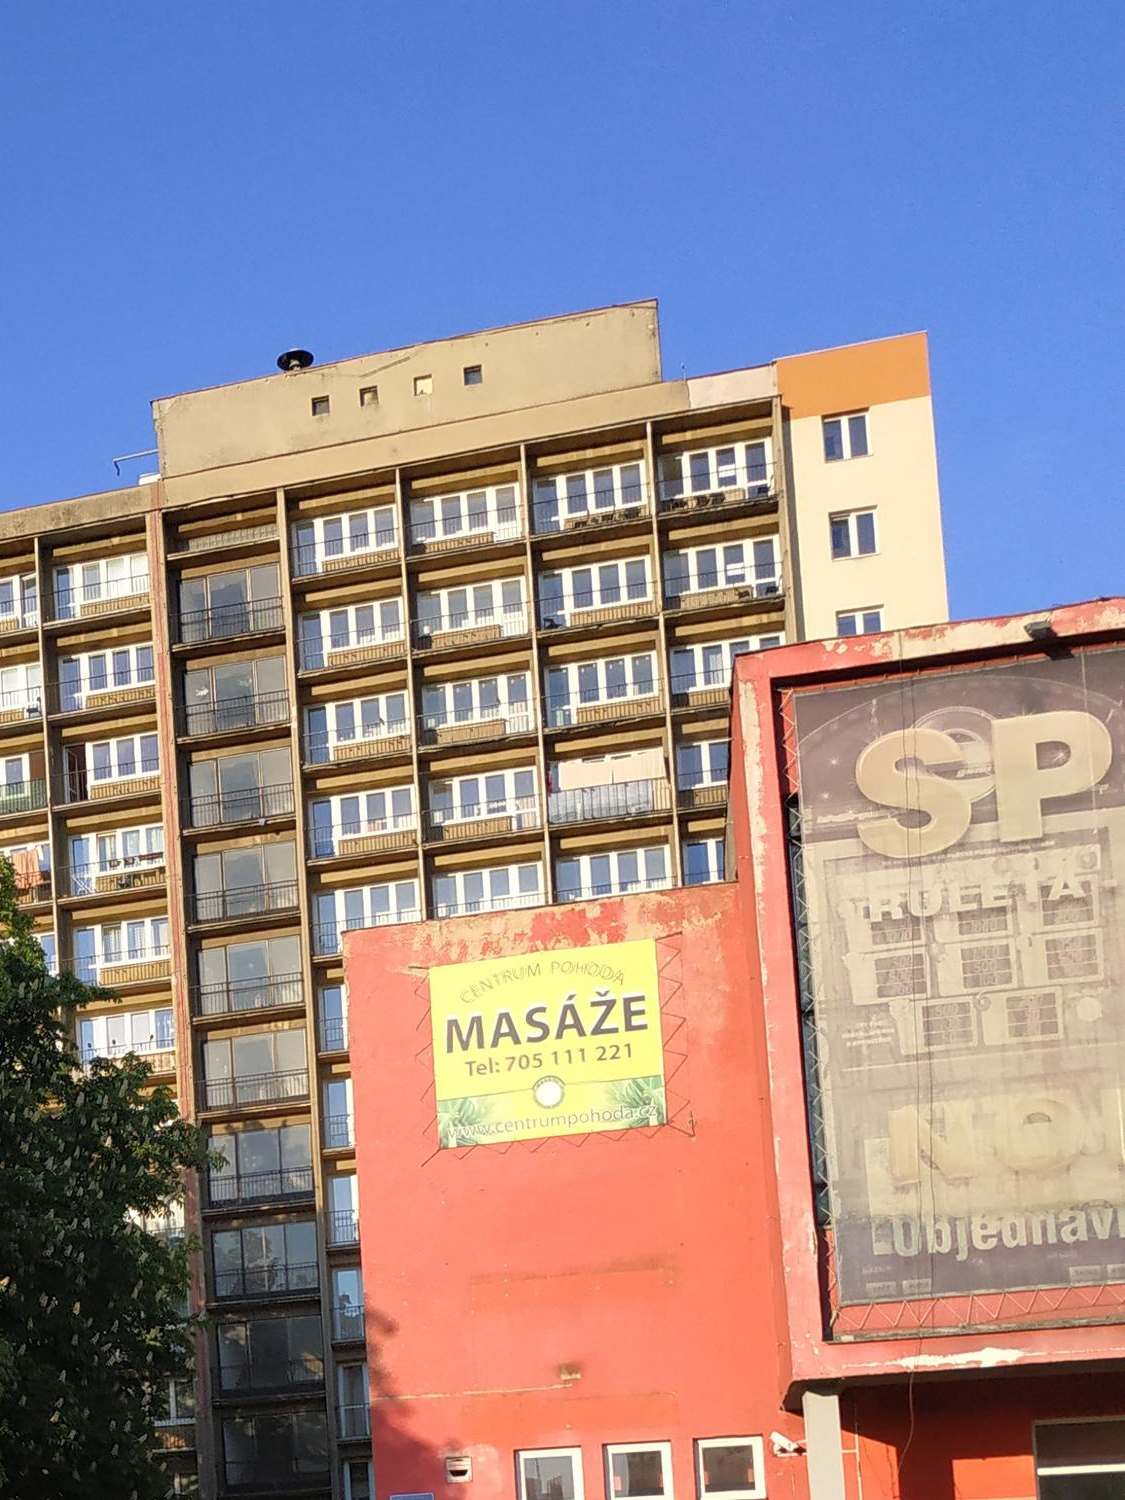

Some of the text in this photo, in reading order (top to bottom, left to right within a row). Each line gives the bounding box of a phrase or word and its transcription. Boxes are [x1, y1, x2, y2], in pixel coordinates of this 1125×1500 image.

[460, 961, 625, 1004] CENTRUM POHODA
[445, 990, 648, 1053] MASÁŽE
[465, 1043, 633, 1077] Tel: 705 111 221
[445, 1104, 657, 1138] www.centrumpohoda.cz
